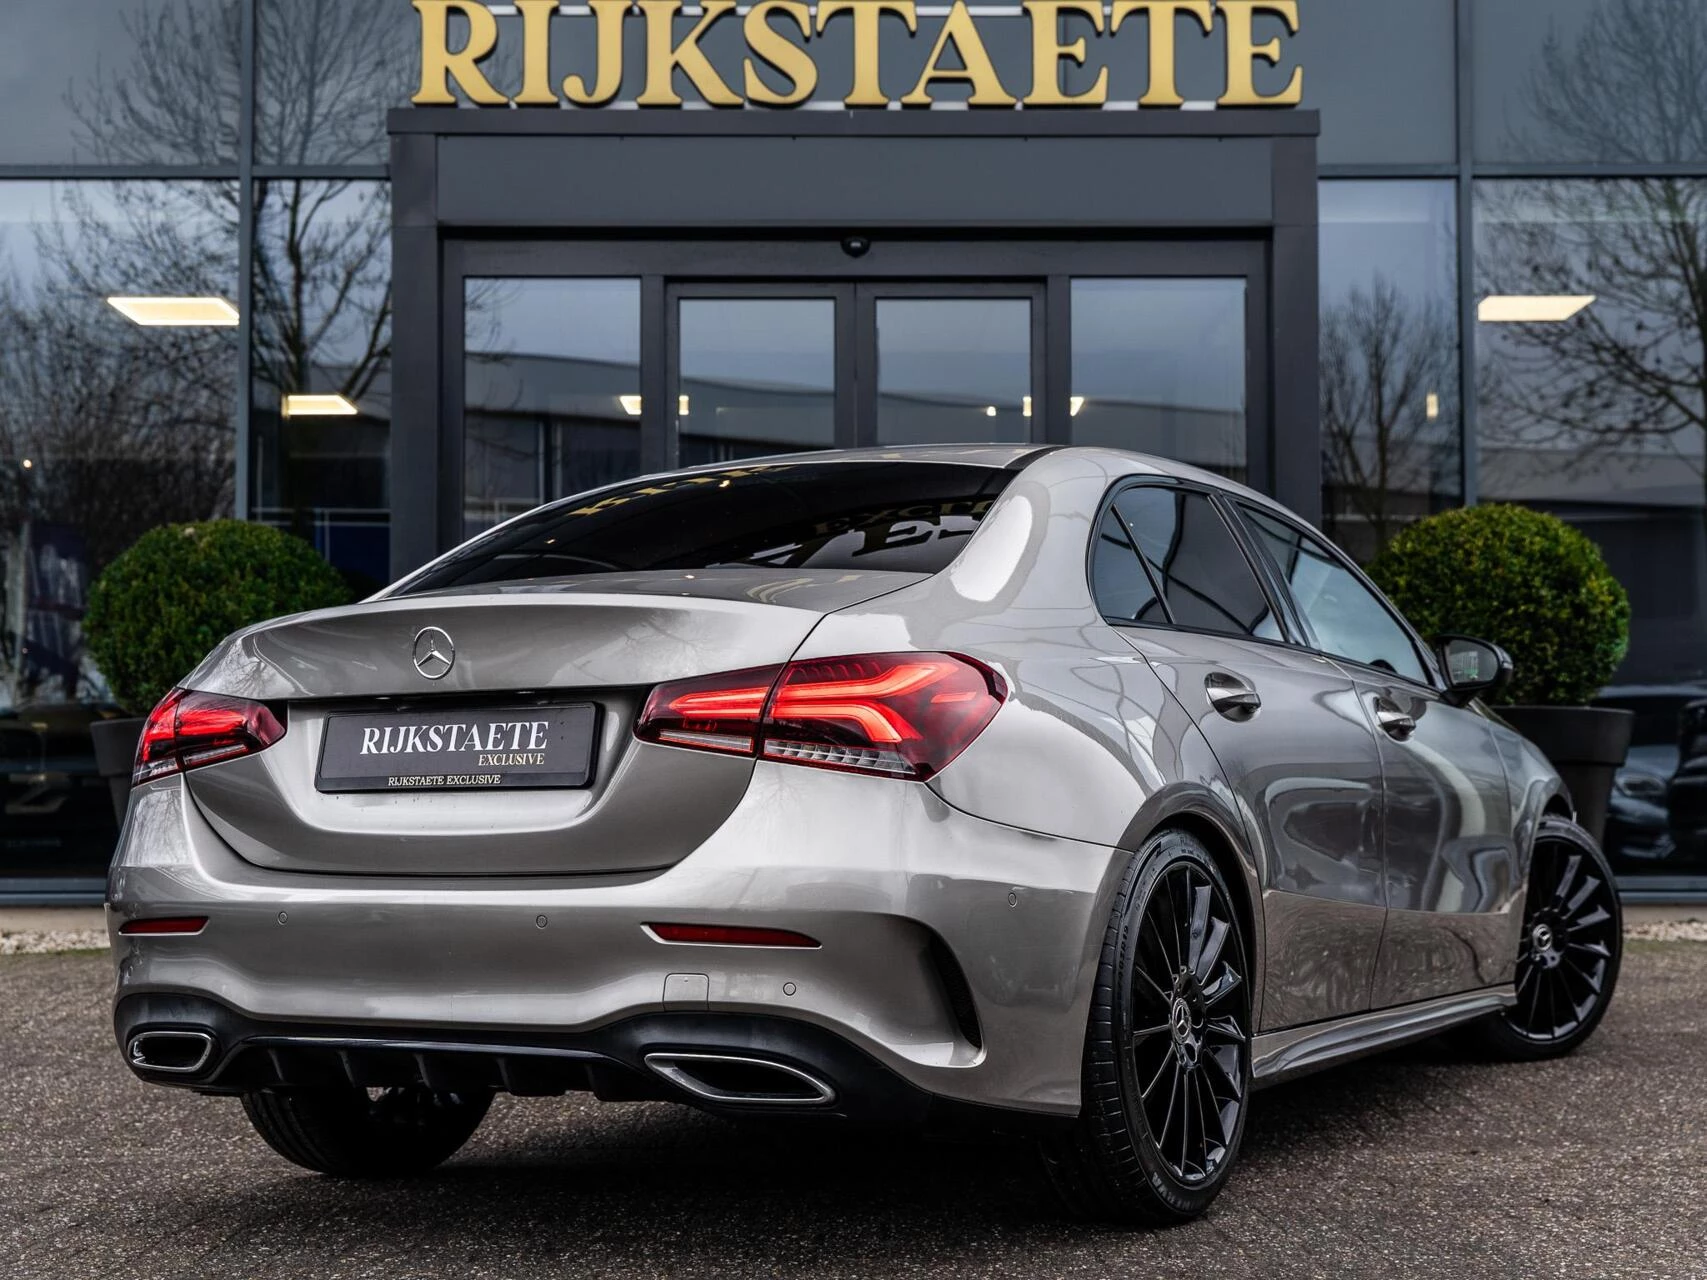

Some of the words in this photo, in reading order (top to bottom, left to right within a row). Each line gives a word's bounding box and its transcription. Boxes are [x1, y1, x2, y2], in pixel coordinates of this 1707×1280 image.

[411, 0, 1303, 105] RIJKSTAETE
[360, 721, 549, 755] RIJKSTAETE
[478, 753, 545, 767] EXCLUSIVE
[388, 776, 444, 786] RIJKSTAETE
[446, 774, 501, 785] EXCLUSIVE
